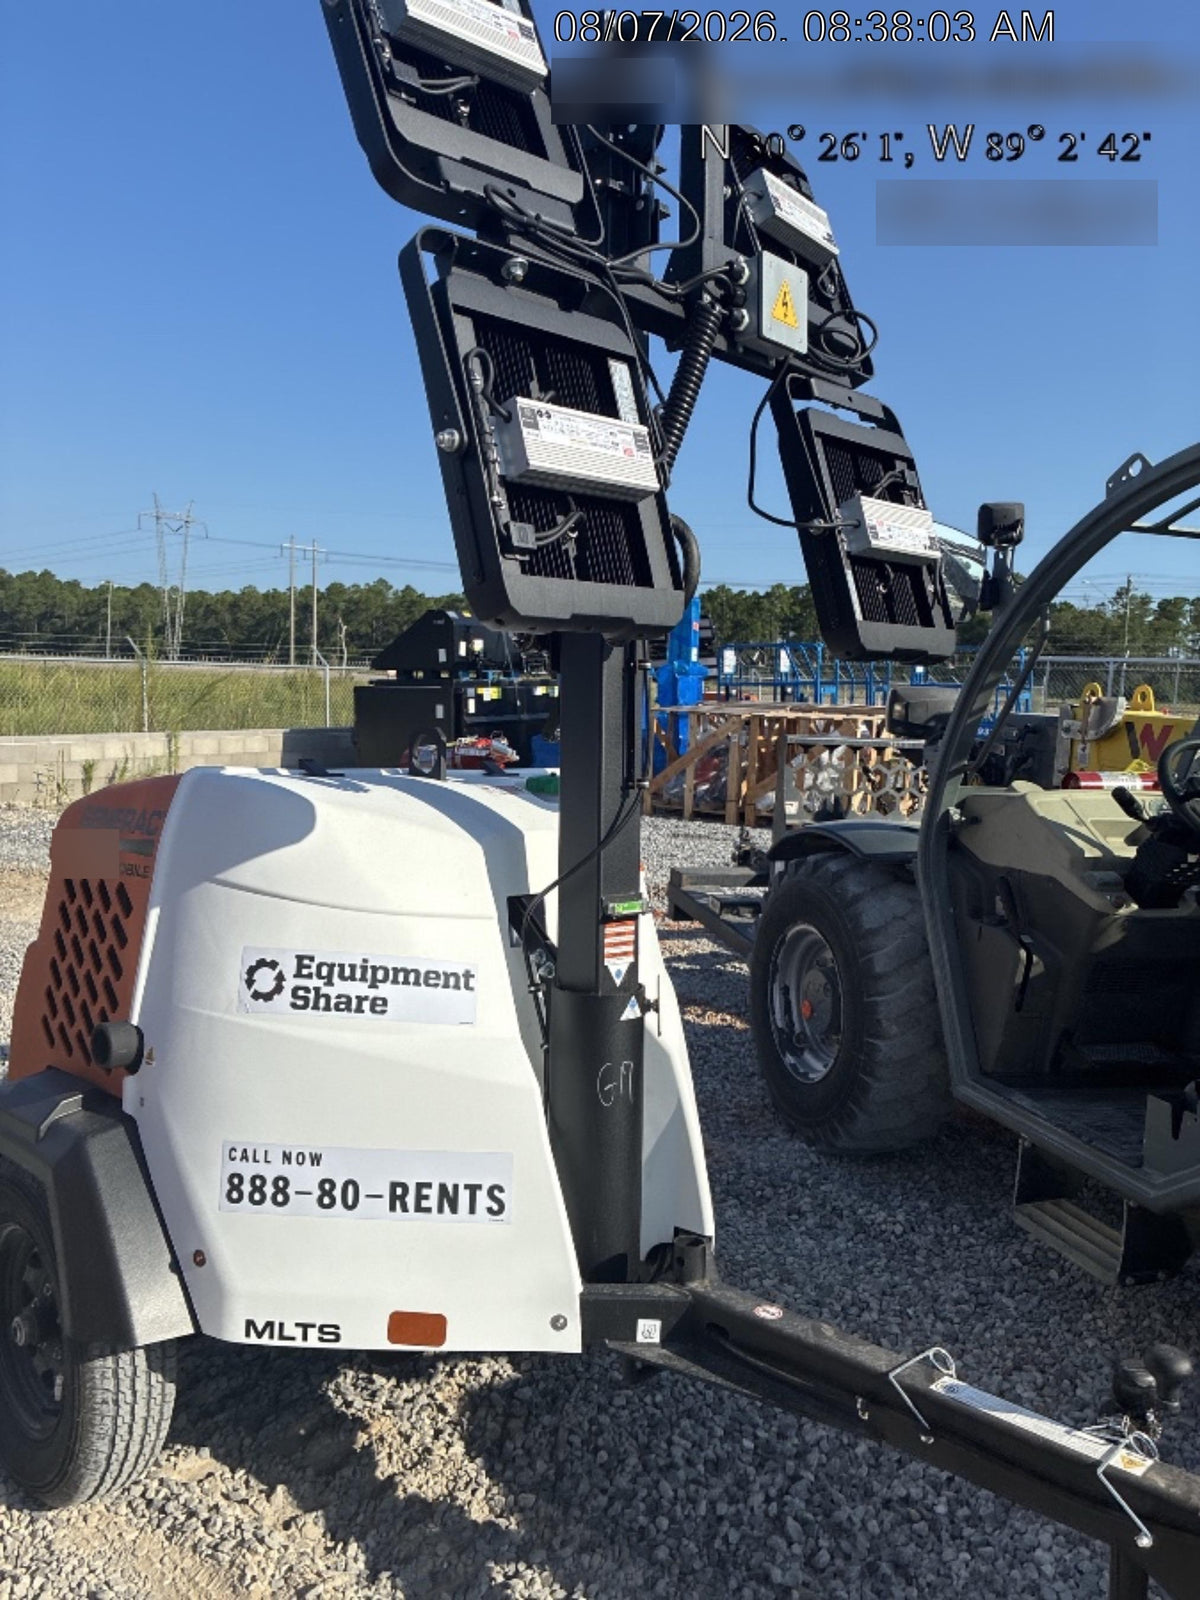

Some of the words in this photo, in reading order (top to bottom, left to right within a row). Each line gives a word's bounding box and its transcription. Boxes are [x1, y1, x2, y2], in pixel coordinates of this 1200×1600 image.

[292, 953, 476, 992] Equipment
[289, 984, 389, 1016] Share
[228, 1147, 272, 1164] CALL
[281, 1150, 323, 1167] NOW
[244, 1318, 342, 1343] MLTS
